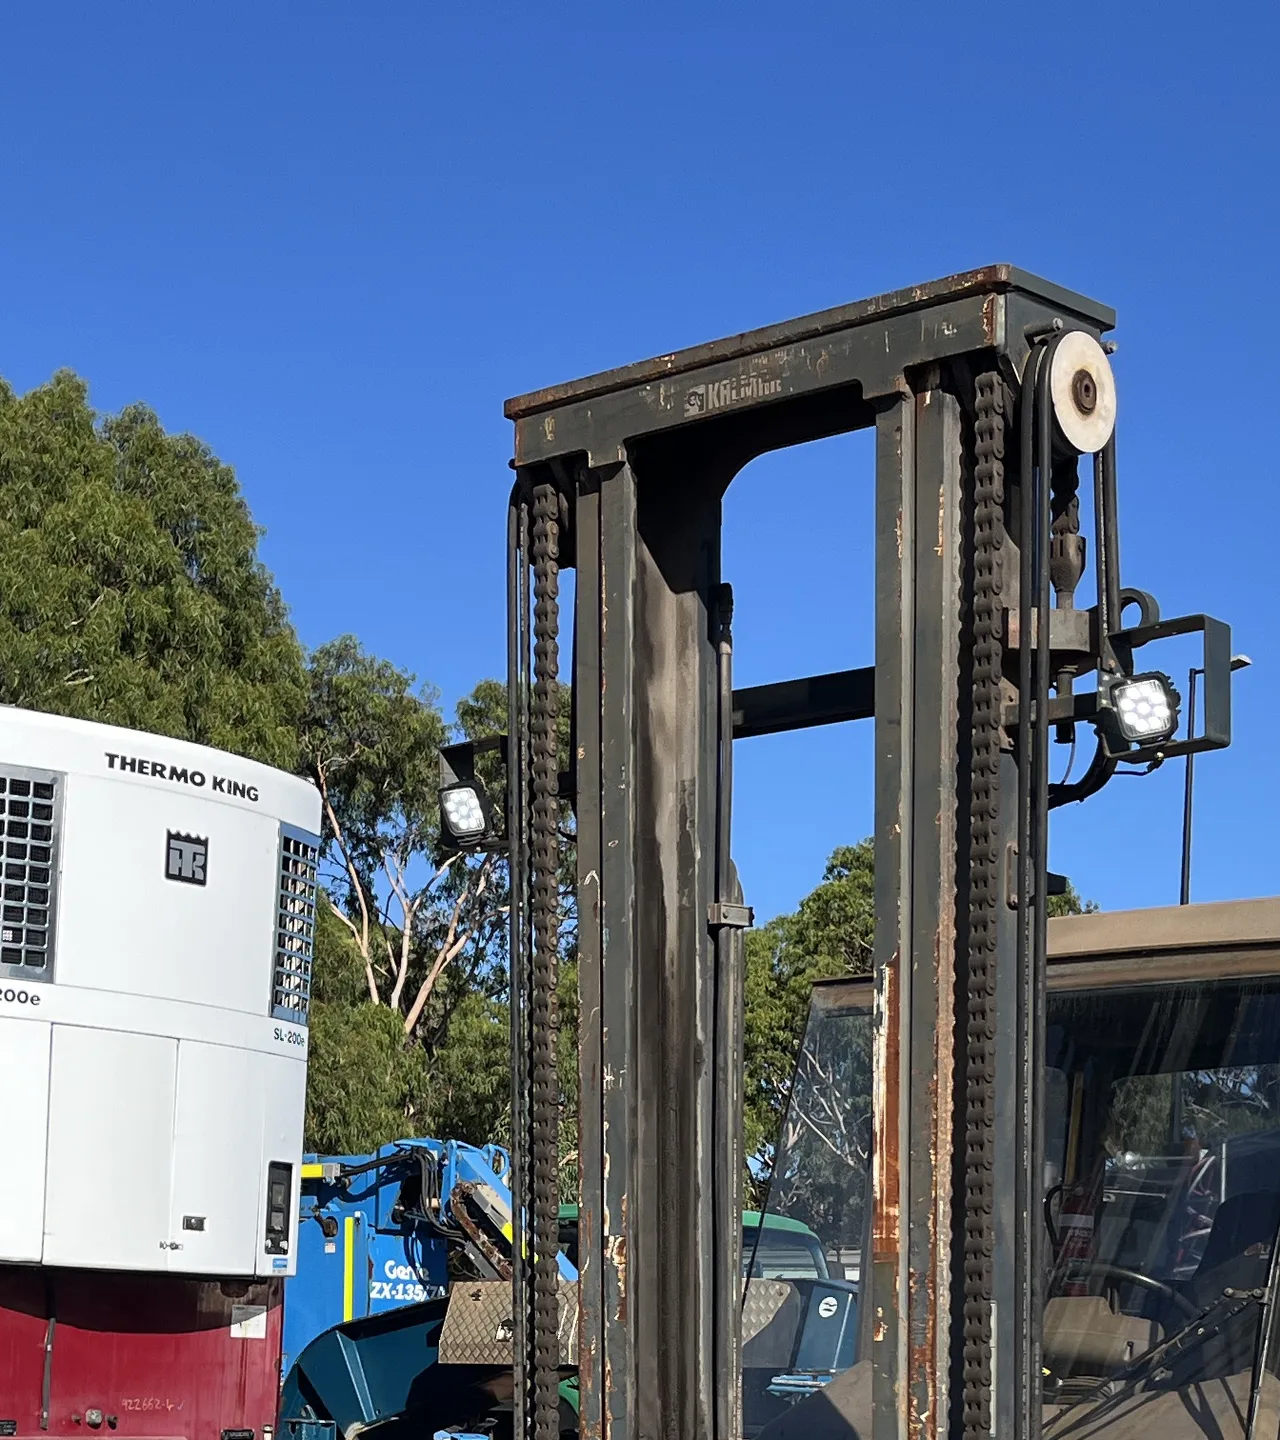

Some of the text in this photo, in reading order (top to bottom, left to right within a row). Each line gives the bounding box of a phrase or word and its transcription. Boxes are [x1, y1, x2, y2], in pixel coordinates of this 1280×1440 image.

[105, 752, 259, 802] THERMO KING
[274, 1027, 305, 1047] SL-200e
